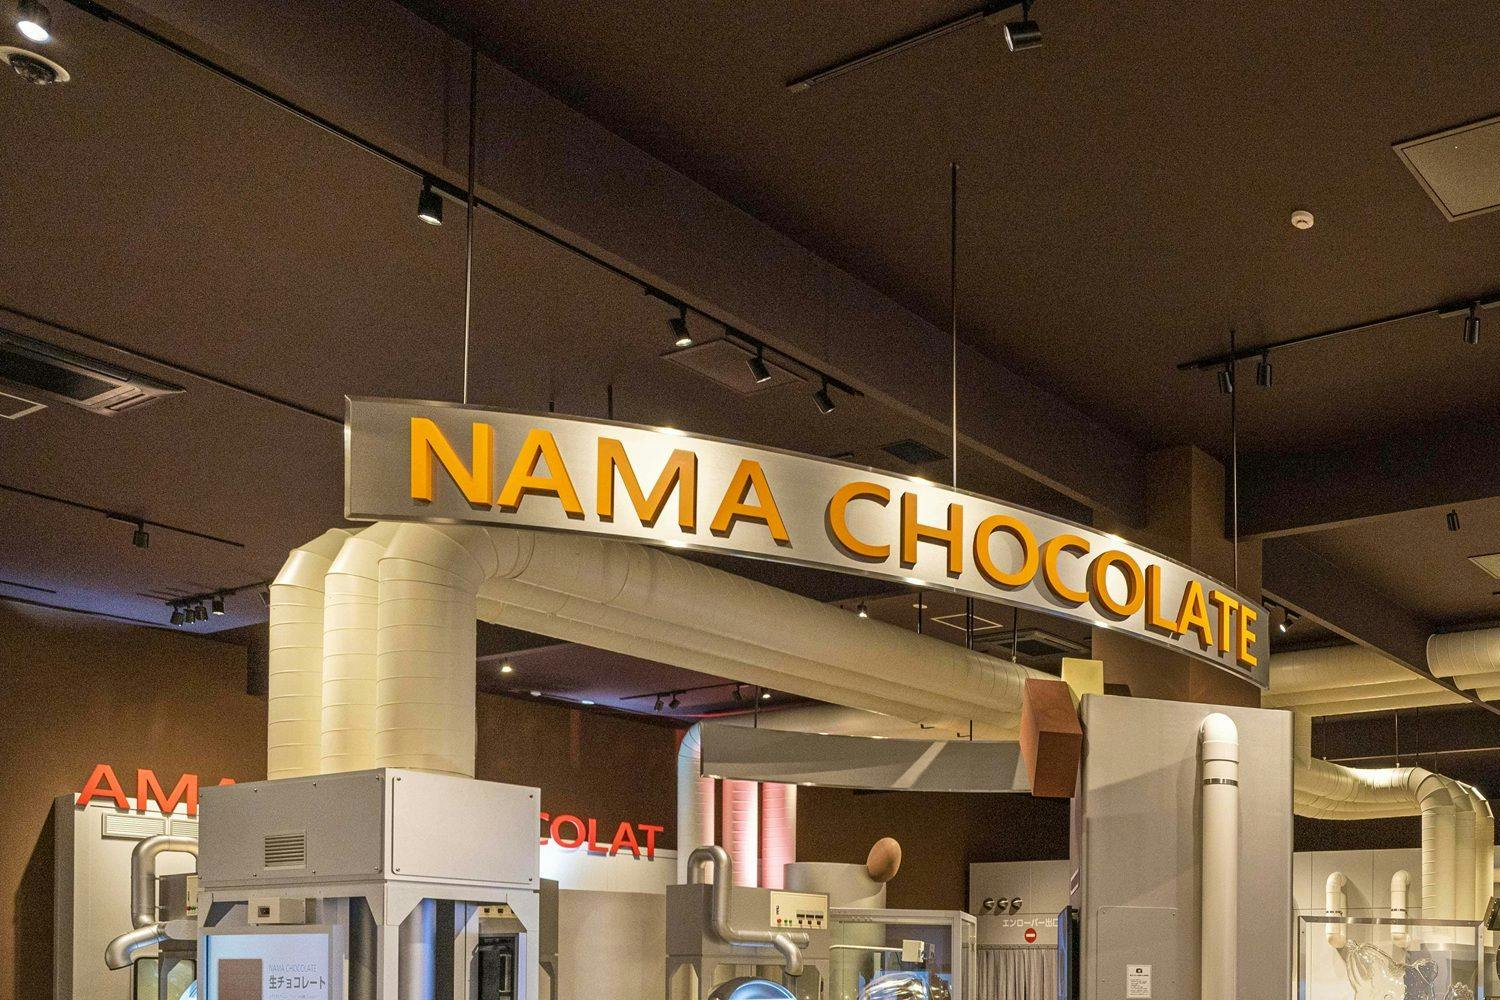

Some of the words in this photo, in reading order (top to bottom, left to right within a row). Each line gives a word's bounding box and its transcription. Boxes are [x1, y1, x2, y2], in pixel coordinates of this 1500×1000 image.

[410, 416, 792, 546] NAMA
[827, 480, 1259, 668] CHOCOLATE
[76, 764, 236, 816] AM
[269, 975, 326, 990] 生チョコレート
